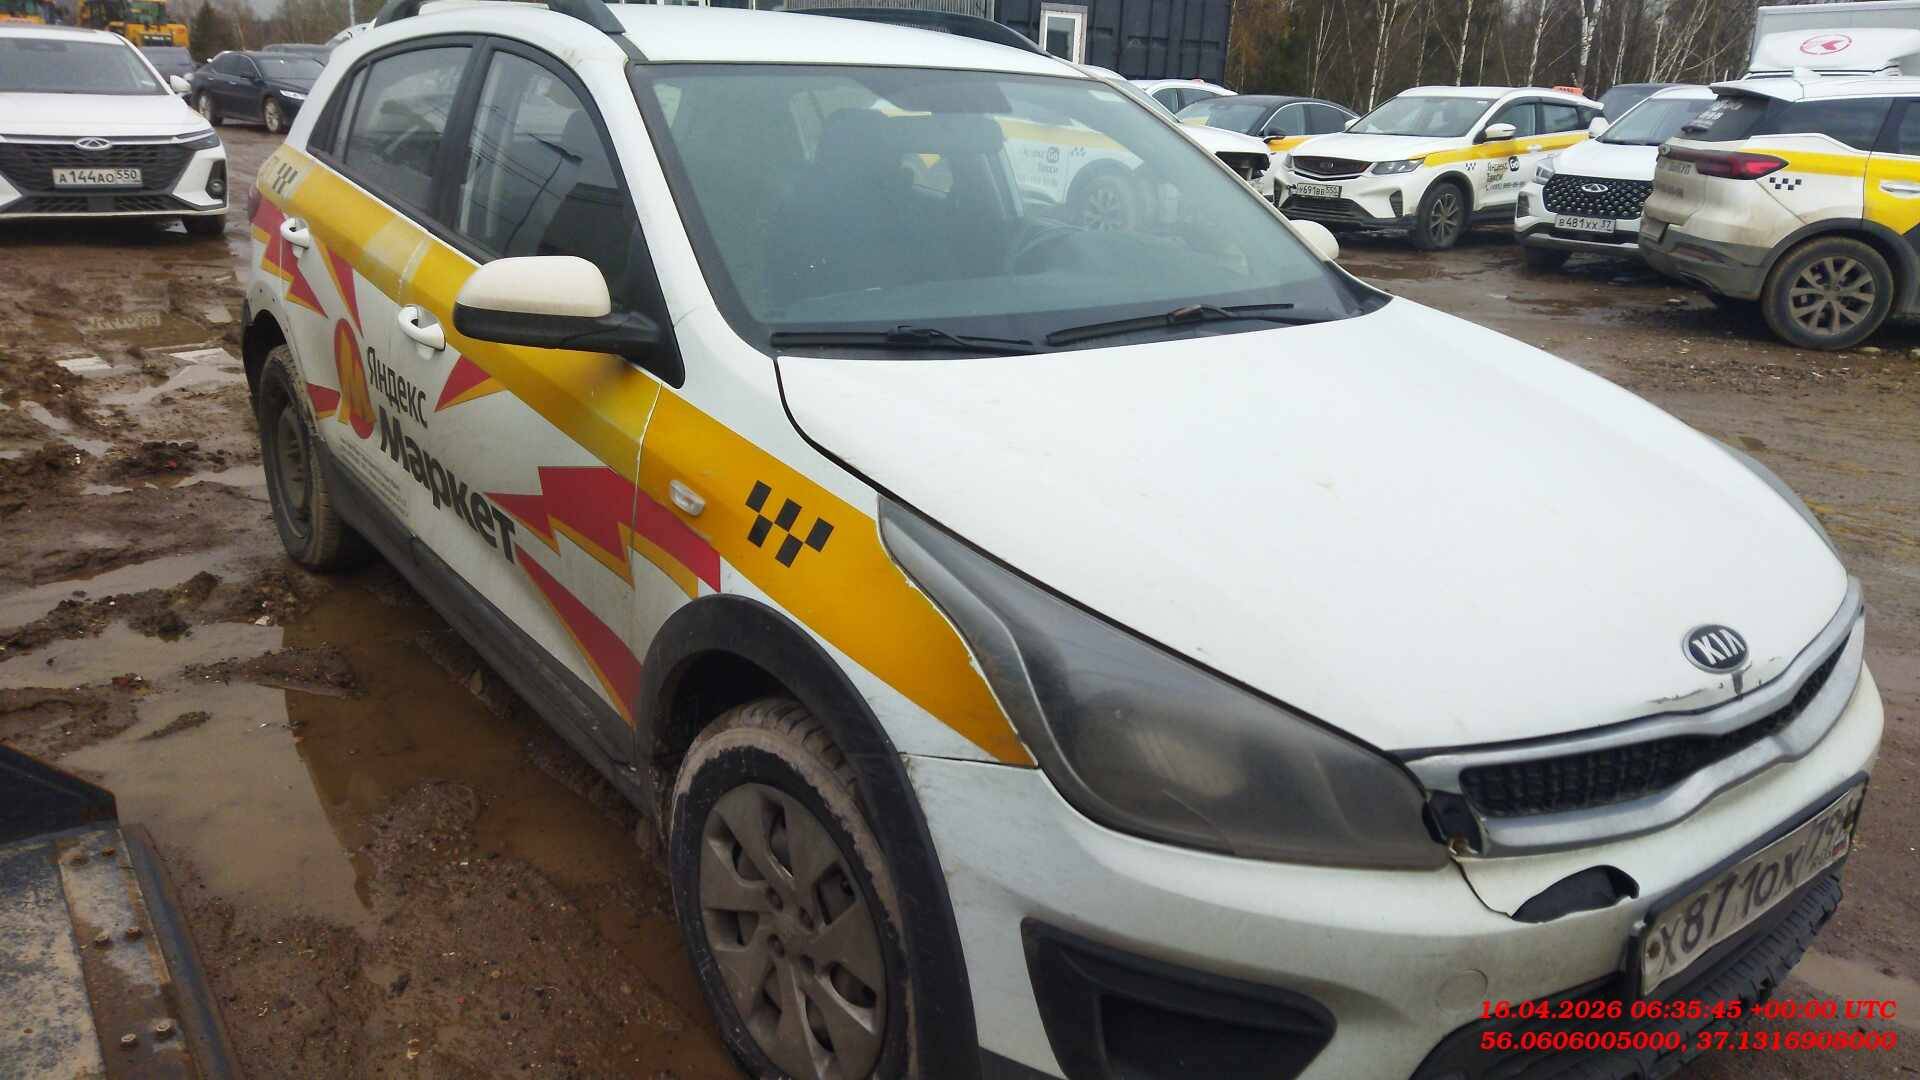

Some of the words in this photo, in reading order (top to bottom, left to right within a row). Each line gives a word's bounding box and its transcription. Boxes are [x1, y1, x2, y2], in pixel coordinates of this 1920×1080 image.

[59, 170, 113, 183] А144АО
[367, 346, 428, 429] Яндекс
[379, 404, 516, 565] Маркет
[1691, 628, 1746, 665] KIA
